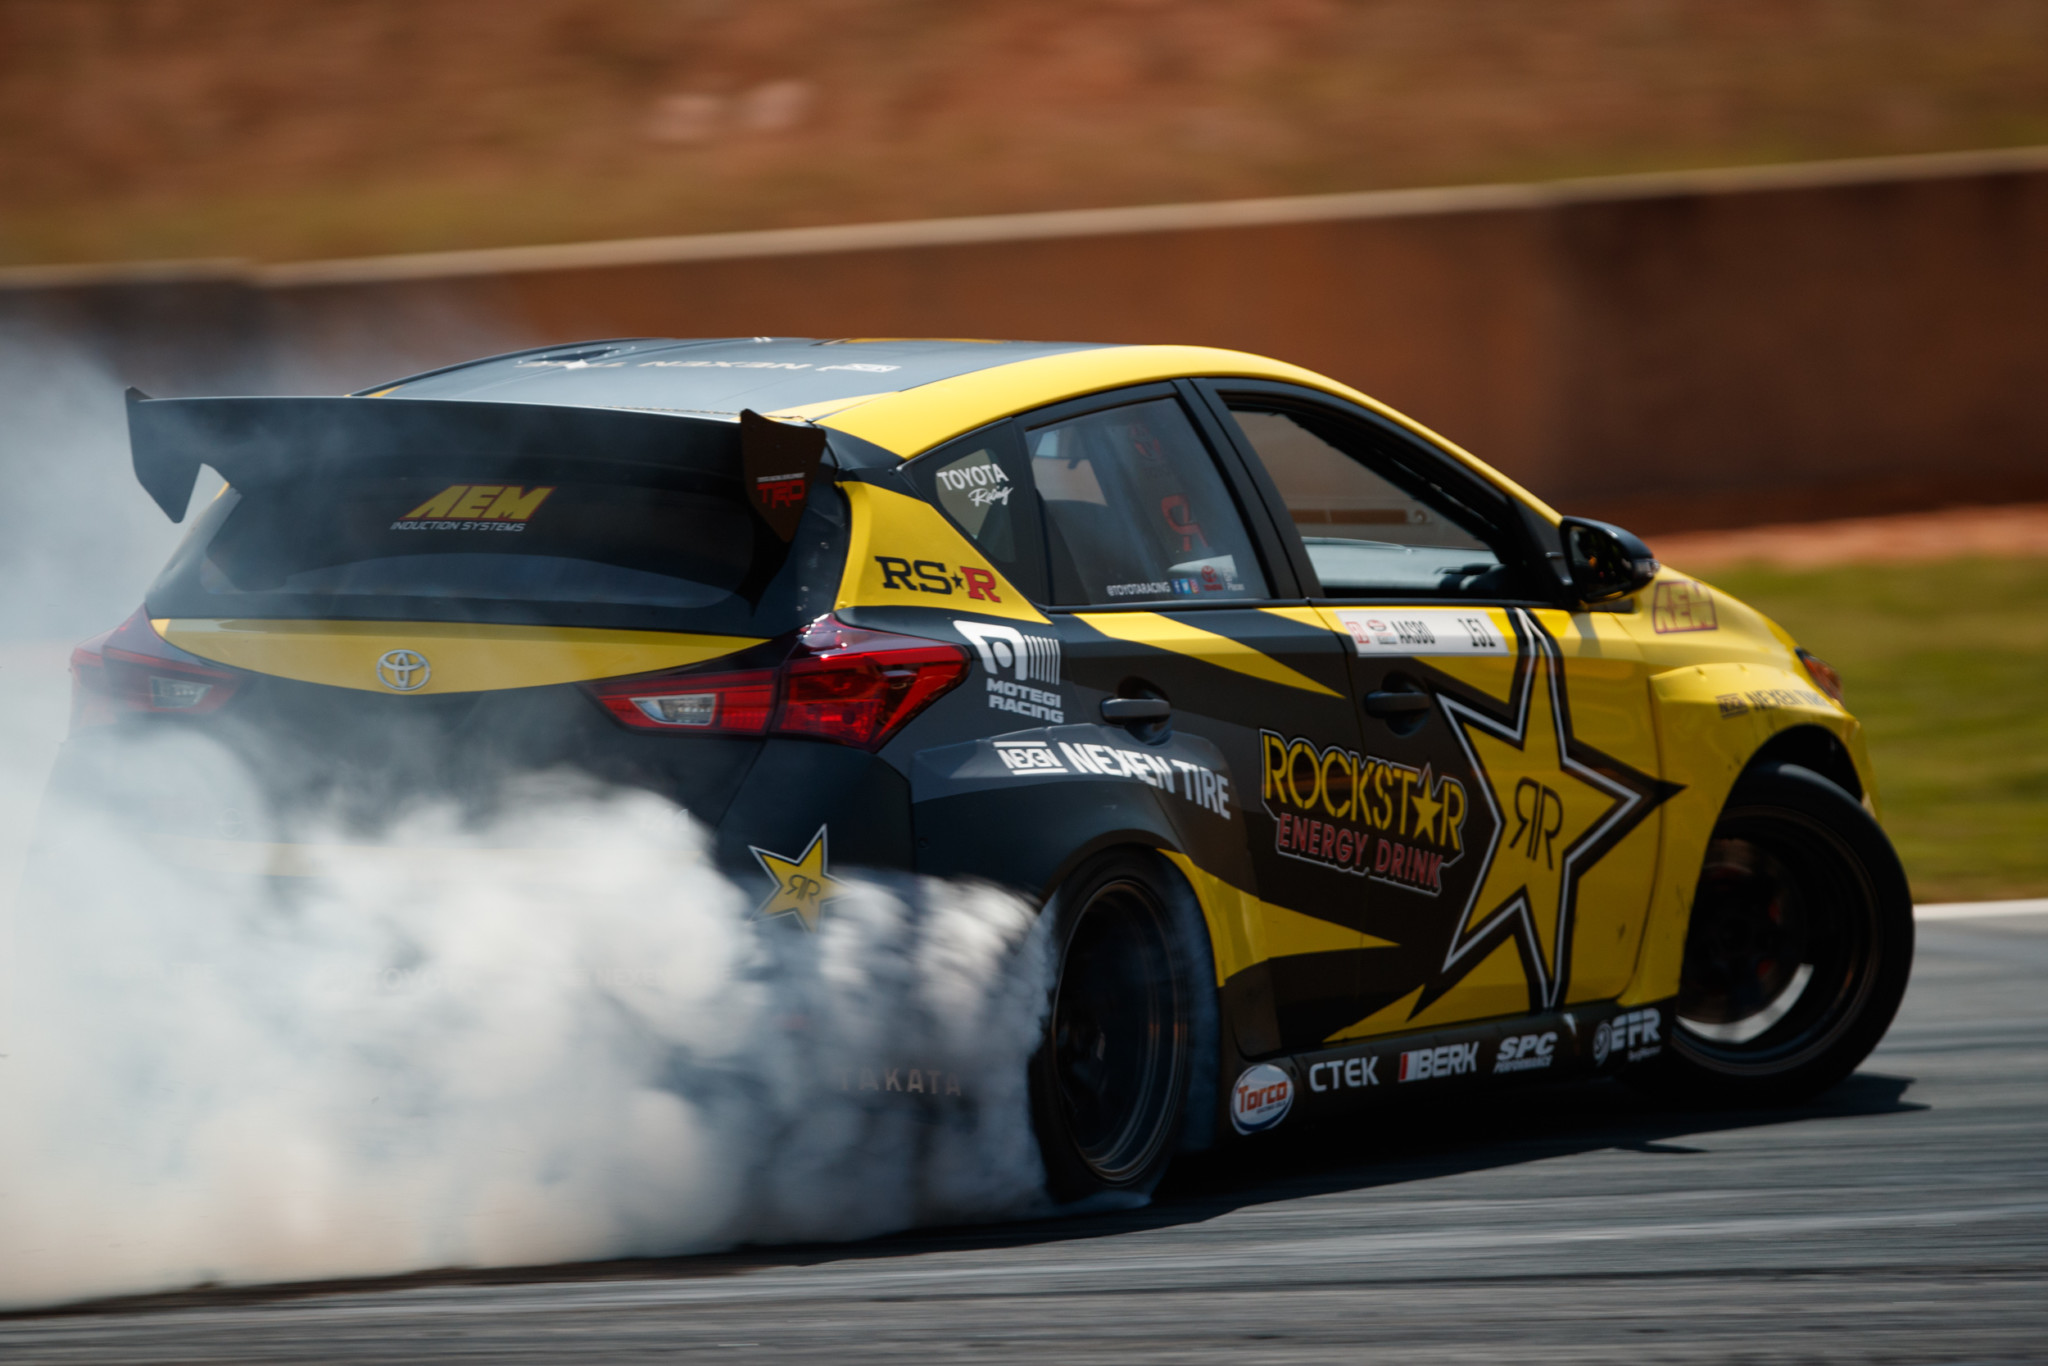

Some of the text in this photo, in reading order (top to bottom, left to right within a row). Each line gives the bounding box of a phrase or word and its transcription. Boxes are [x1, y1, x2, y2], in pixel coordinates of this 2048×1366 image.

[936, 463, 1009, 490] TOYOTA
[400, 485, 556, 522] AEM
[757, 480, 805, 509] TRD
[968, 486, 1013, 507] Racing
[390, 521, 526, 532] INDUCTION SYSTEMS
[1653, 580, 1718, 635] AEM
[986, 678, 1061, 708] MOTEGI
[989, 694, 1064, 724] RACING
[1059, 741, 1175, 794] NEXEN
[1171, 758, 1232, 830] TIRE
[1278, 812, 1444, 889] ENERGY DRINK
[1611, 1008, 1662, 1051] EFR
[1416, 1042, 1480, 1079] BERK
[1495, 1031, 1558, 1062] SPC
[838, 1065, 961, 1097] TAKATA
[1308, 1056, 1379, 1092] CTEK
[1237, 1080, 1288, 1114] Torco
